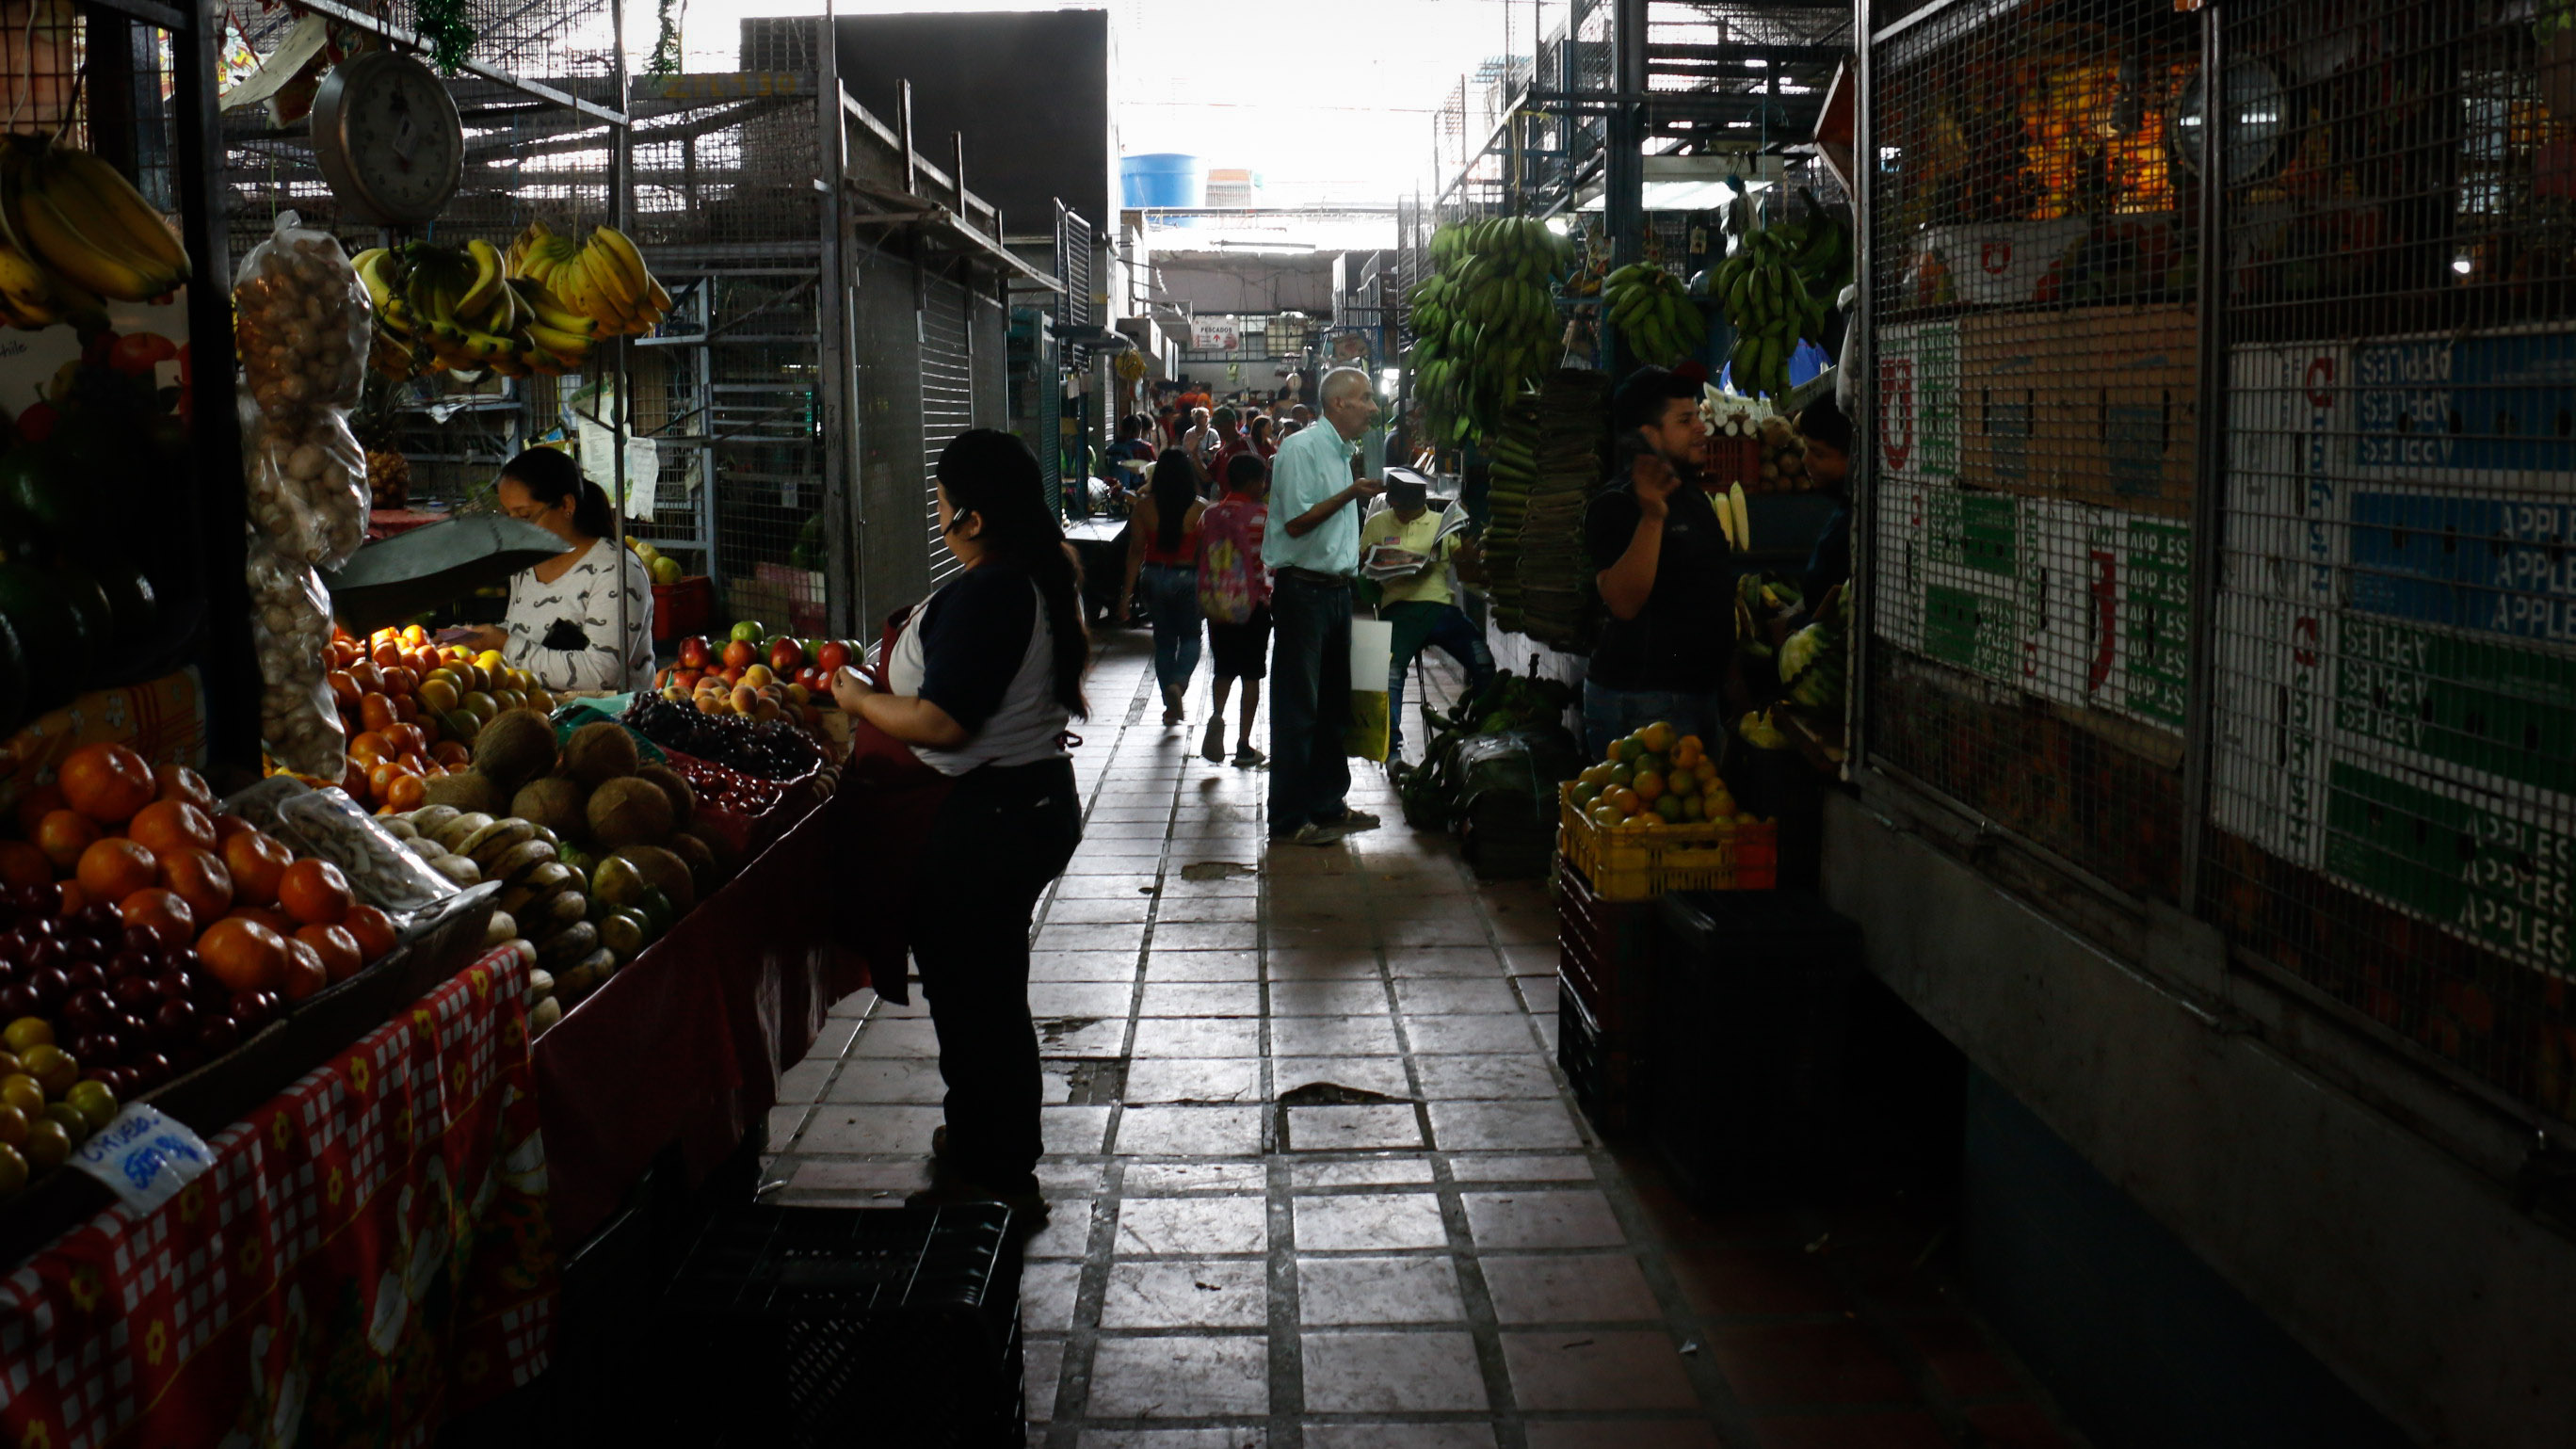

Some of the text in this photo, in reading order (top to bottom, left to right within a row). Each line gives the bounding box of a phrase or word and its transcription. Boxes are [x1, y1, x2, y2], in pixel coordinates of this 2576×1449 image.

[2361, 346, 2453, 383] APPLES
[2361, 389, 2454, 424] APPLES
[2361, 428, 2455, 462] APPLES
[2464, 813, 2570, 877] APPLES
[2461, 859, 2573, 917] APPLES
[2457, 892, 2572, 966] APPLES
